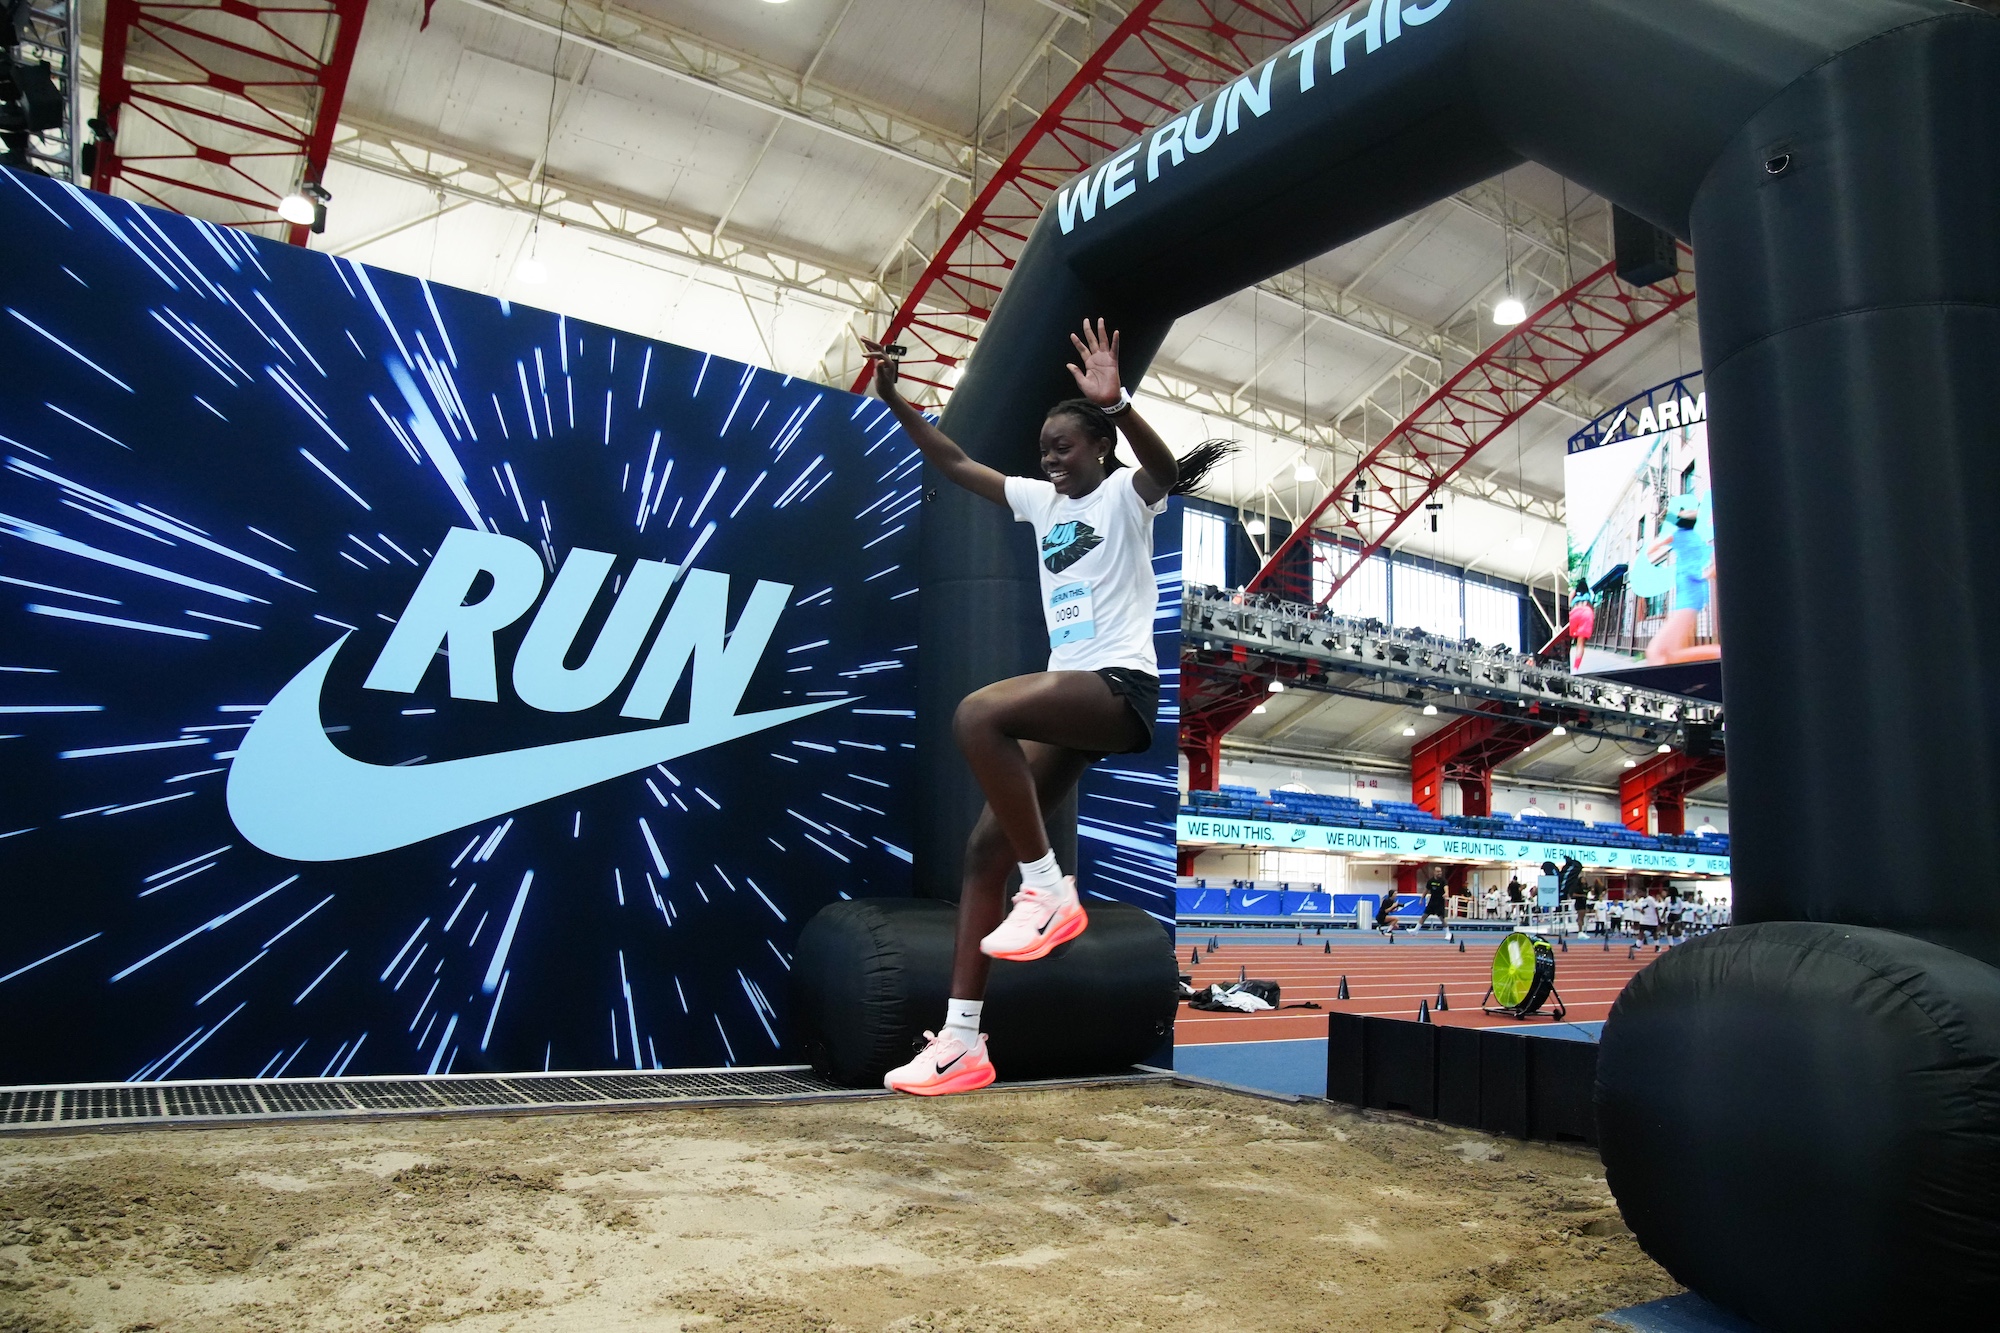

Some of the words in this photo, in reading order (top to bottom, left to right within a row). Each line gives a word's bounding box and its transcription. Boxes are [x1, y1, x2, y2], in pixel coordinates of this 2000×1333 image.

[1057, 142, 1142, 236] WE
[1147, 58, 1278, 184] RUN
[1056, 605, 1079, 622] 0090
[362, 526, 795, 724] RUN
[1188, 822, 1209, 836] WE
[1213, 823, 1240, 838] RUN
[1244, 826, 1275, 841] THIS.
[1326, 832, 1344, 846] WE
[1347, 834, 1371, 847] RUN
[1373, 835, 1400, 849] THIS.
[1443, 840, 1459, 853] WE
[1461, 842, 1482, 855] RUN
[1484, 843, 1507, 856] THIS.
[1543, 848, 1557, 859] WE
[1578, 850, 1598, 862] THIS.
[1630, 853, 1642, 865] WE
[1643, 854, 1659, 866] RUN
[1706, 859, 1717, 869] WE
